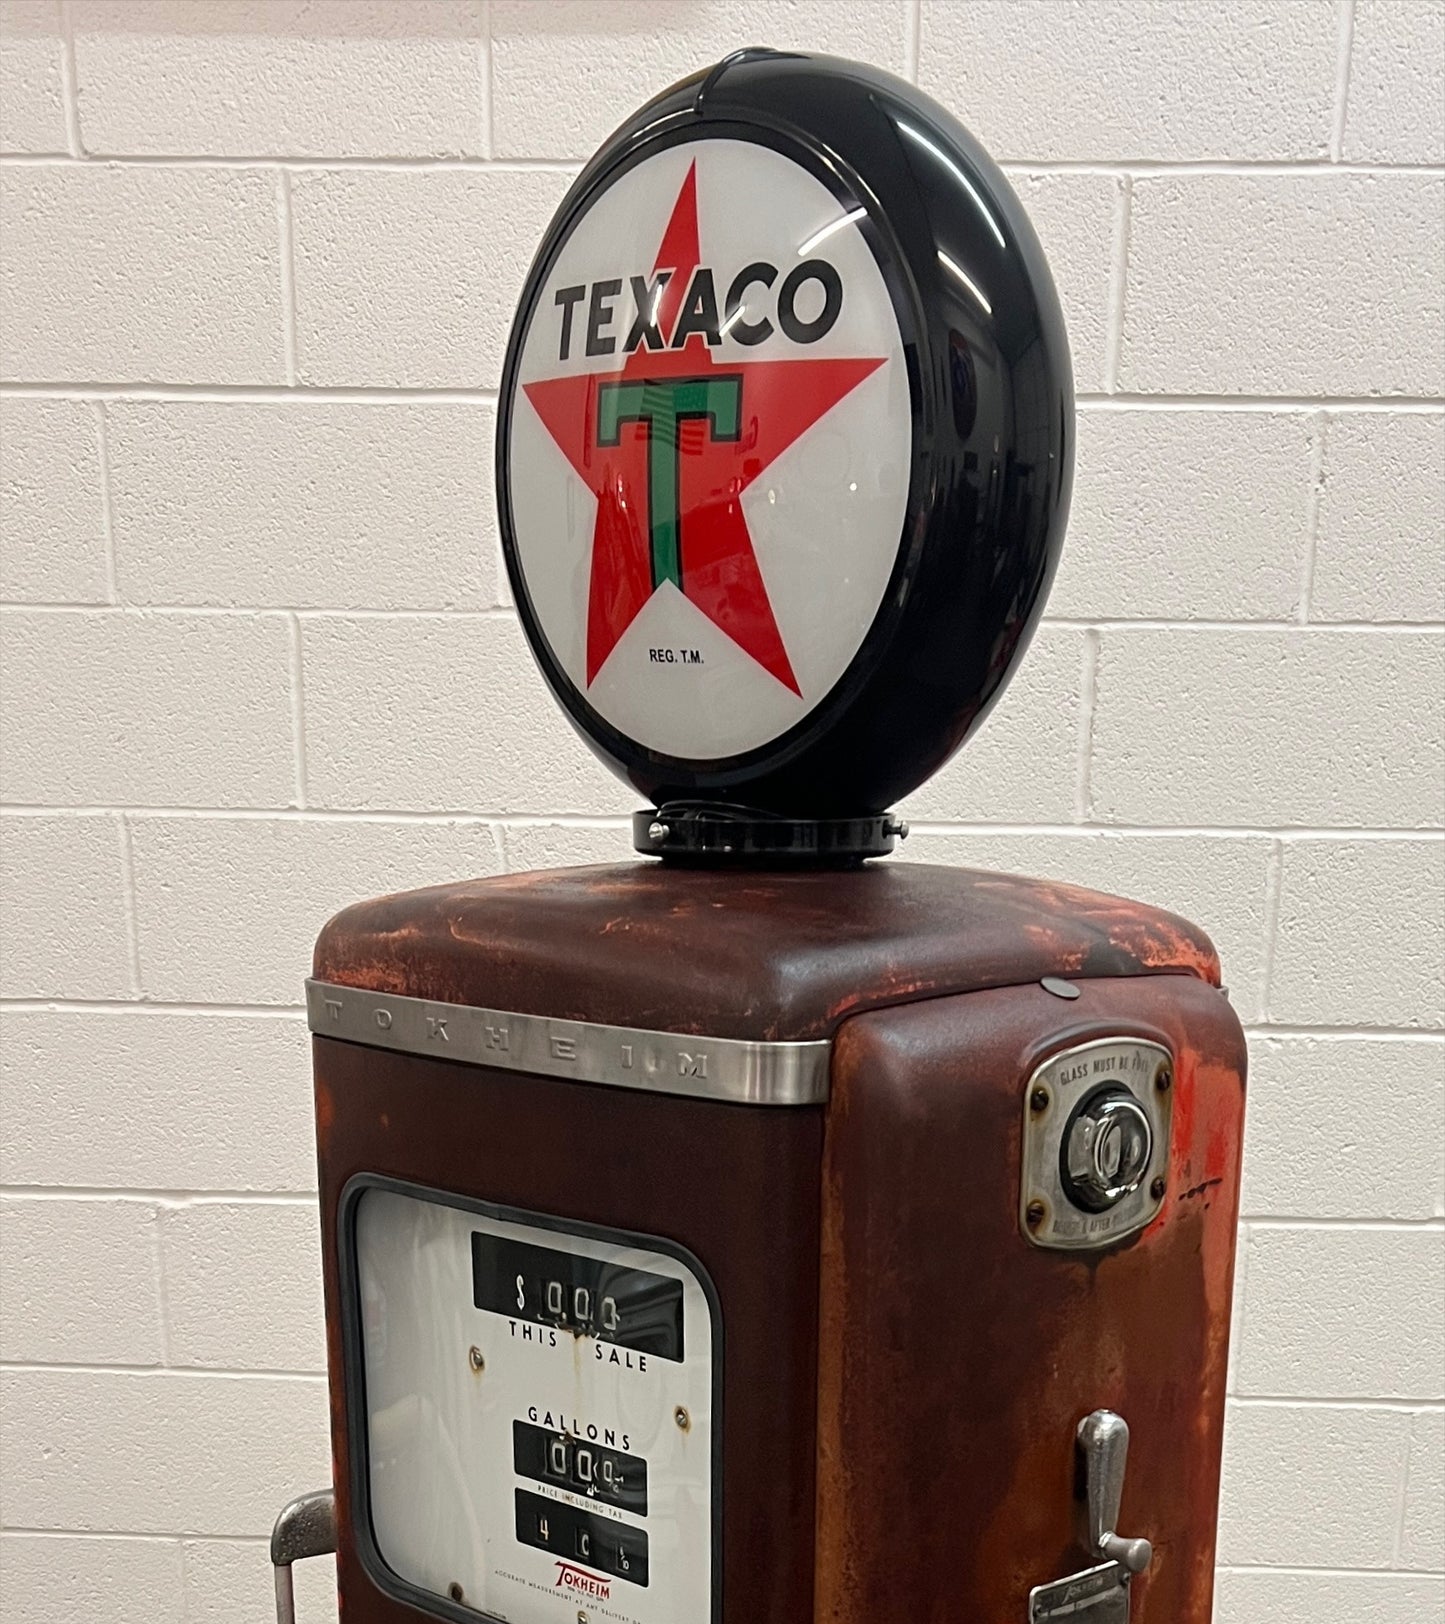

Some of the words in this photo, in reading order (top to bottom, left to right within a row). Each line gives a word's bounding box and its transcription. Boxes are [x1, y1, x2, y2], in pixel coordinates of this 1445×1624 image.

[555, 257, 844, 361] TEXACO
[599, 373, 744, 595] T
[649, 648, 678, 663] REG.
[680, 649, 704, 664] T.M.
[325, 999, 709, 1079] TOKHEIM
[1060, 1063, 1088, 1086] GLASS
[1093, 1056, 1116, 1073] MUST
[509, 1320, 557, 1348] THIS
[595, 1343, 647, 1373] SALE
[528, 1406, 631, 1451] GALLONS
[537, 1484, 559, 1500] PRICE
[561, 1492, 605, 1514] INCLUDING
[608, 1507, 623, 1520] TAX
[540, 1519, 549, 1541] 4
[494, 1569, 526, 1586] ACCURATE
[554, 1560, 612, 1600] TOKHEIM
